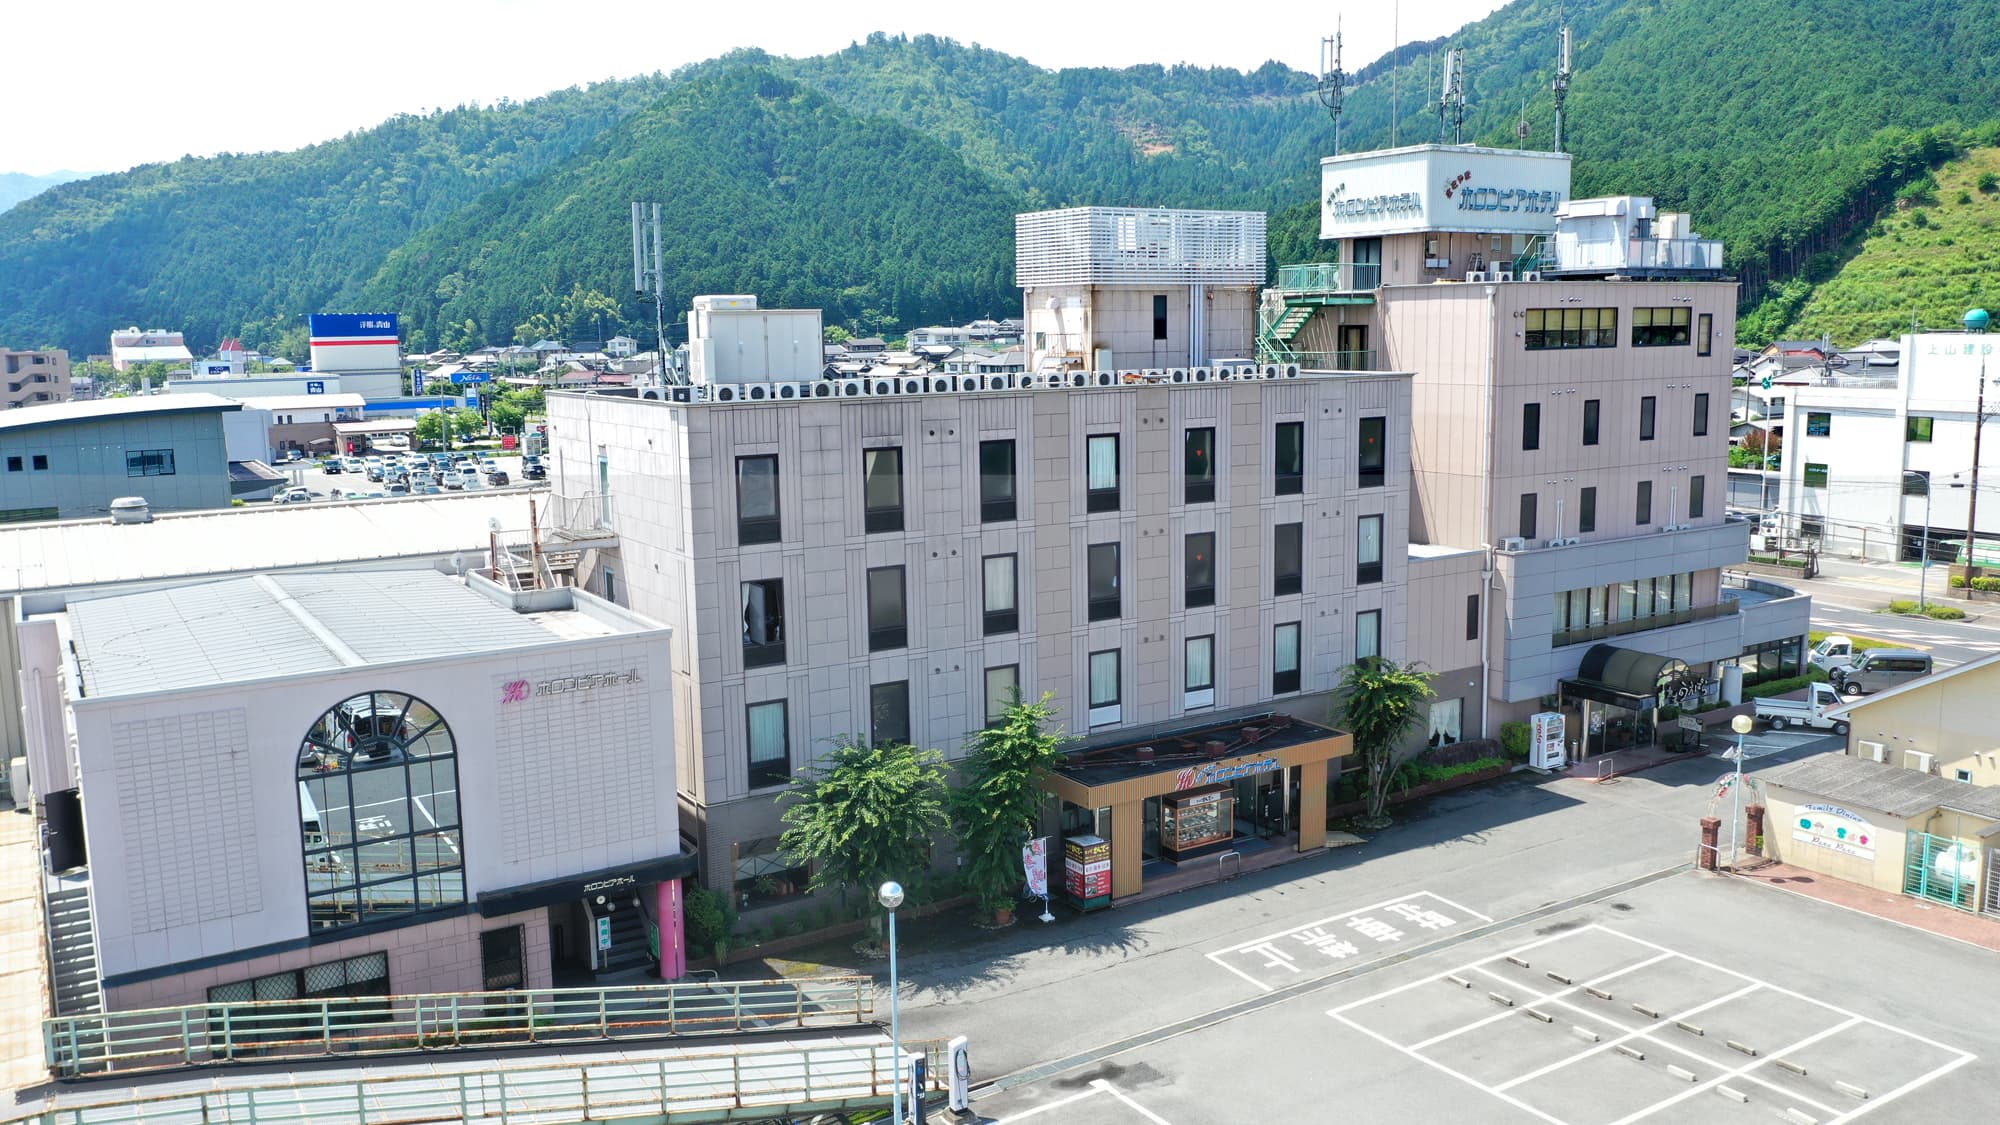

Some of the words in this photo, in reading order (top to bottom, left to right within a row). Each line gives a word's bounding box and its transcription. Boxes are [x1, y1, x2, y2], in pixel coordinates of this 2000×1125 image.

[1927, 343, 2000, 355] 上山建設
[536, 668, 641, 696] ホロンピアホール
[584, 875, 635, 893] ホロンピアホール
[1238, 903, 1457, 973] 駐車禁止
